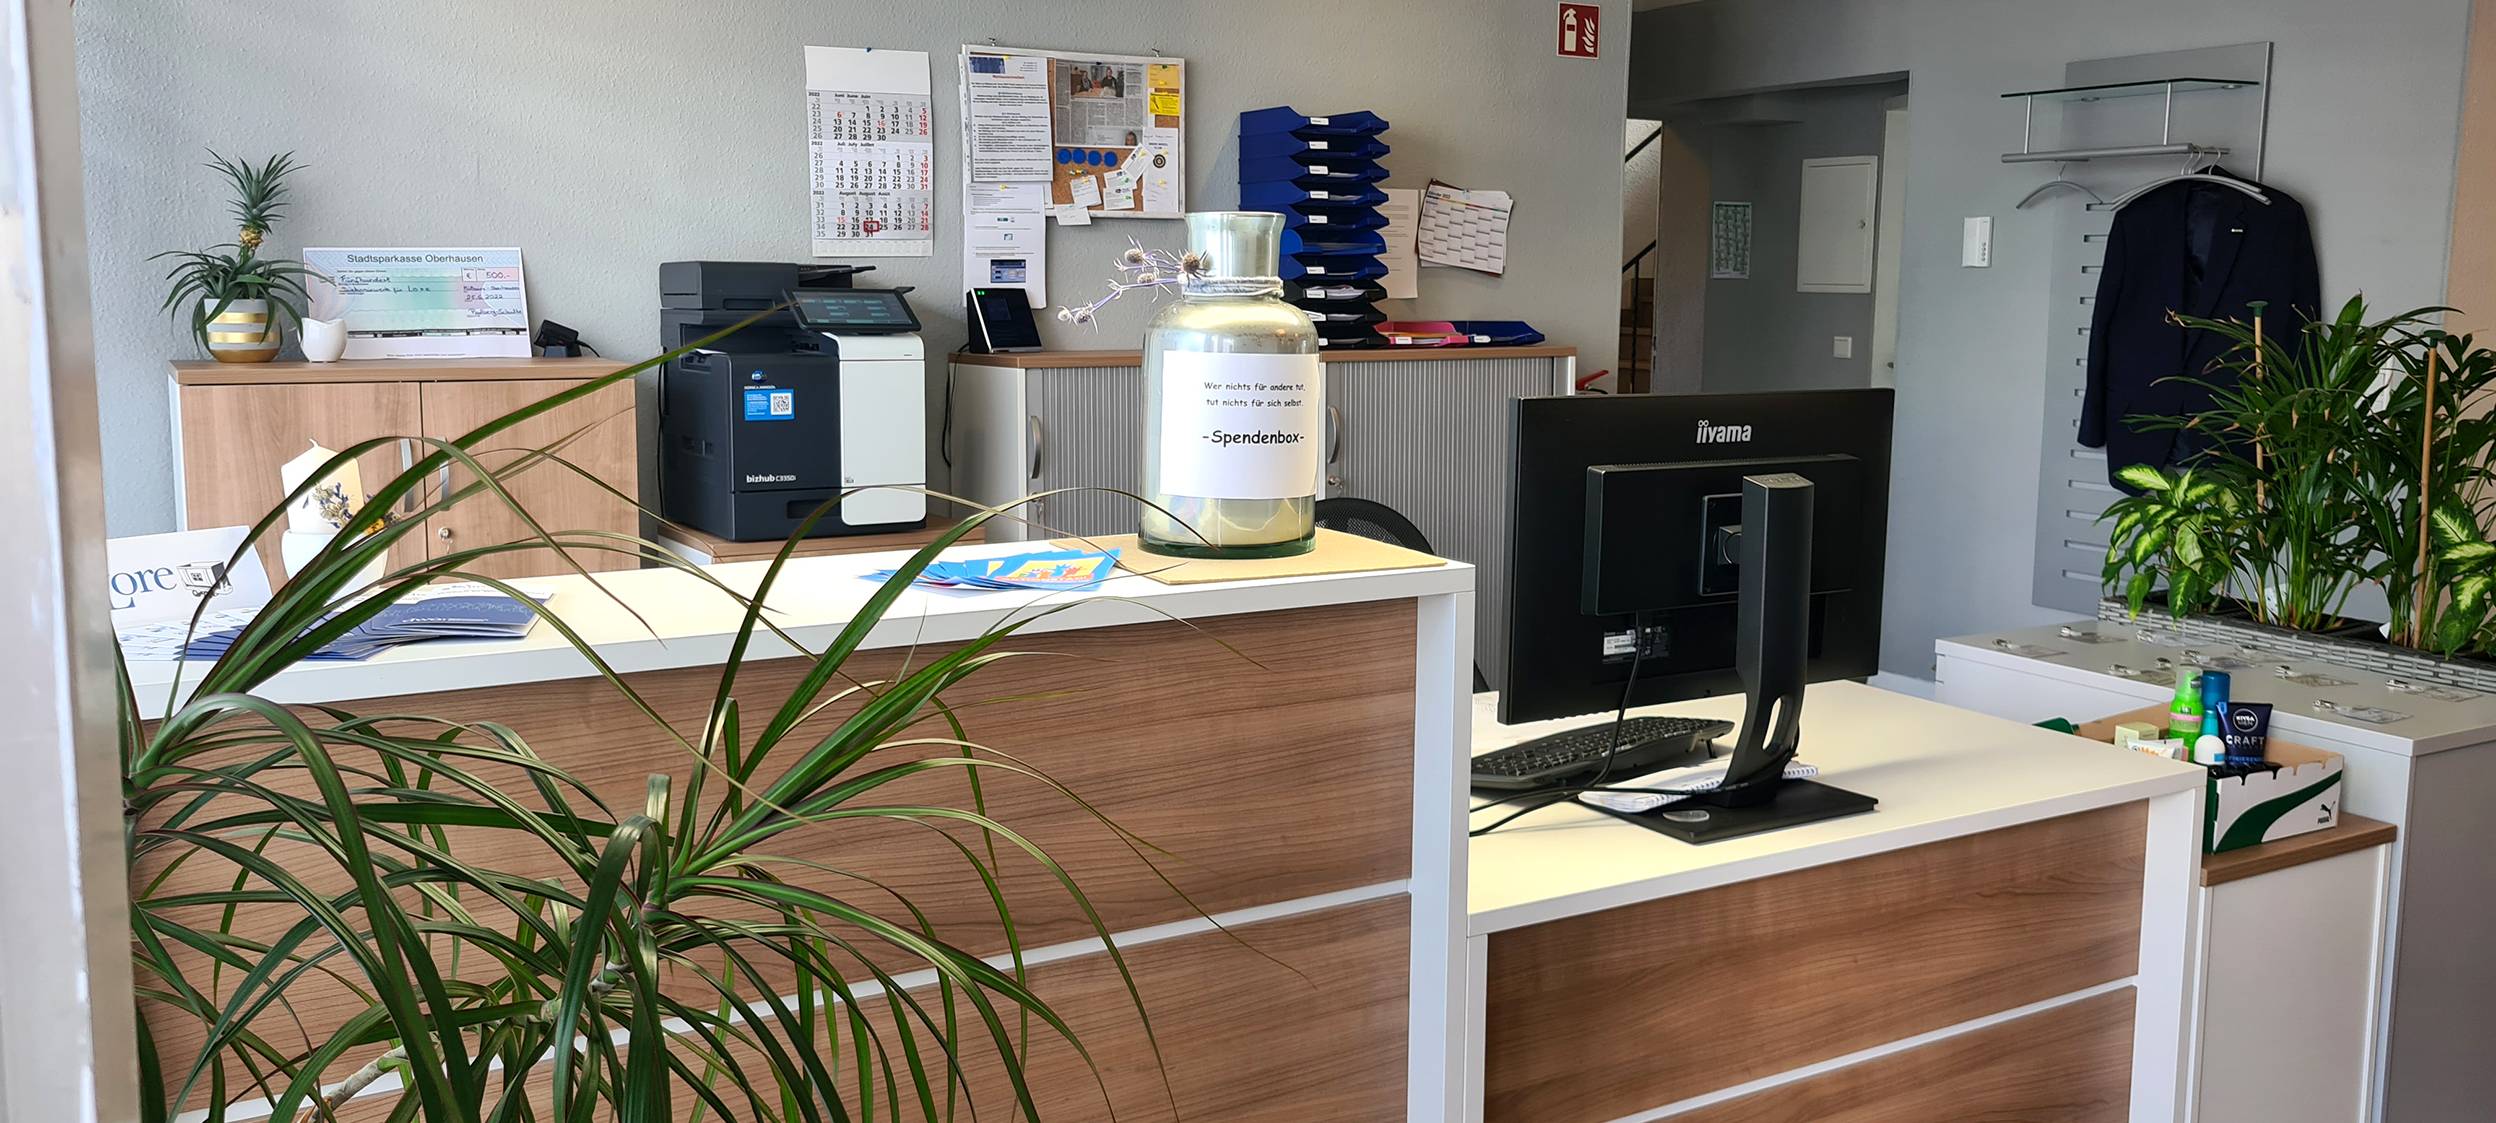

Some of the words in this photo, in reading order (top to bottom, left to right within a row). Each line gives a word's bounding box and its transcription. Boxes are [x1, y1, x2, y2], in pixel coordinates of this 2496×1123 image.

[347, 254, 422, 264] Stadtsparkasse
[425, 254, 484, 262] Oberhausen
[1204, 382, 1222, 390] Wer
[1255, 383, 1267, 391] für
[1696, 420, 1752, 444] iiyama
[746, 474, 774, 483] bizhub
[2226, 735, 2264, 744] CRAFT
